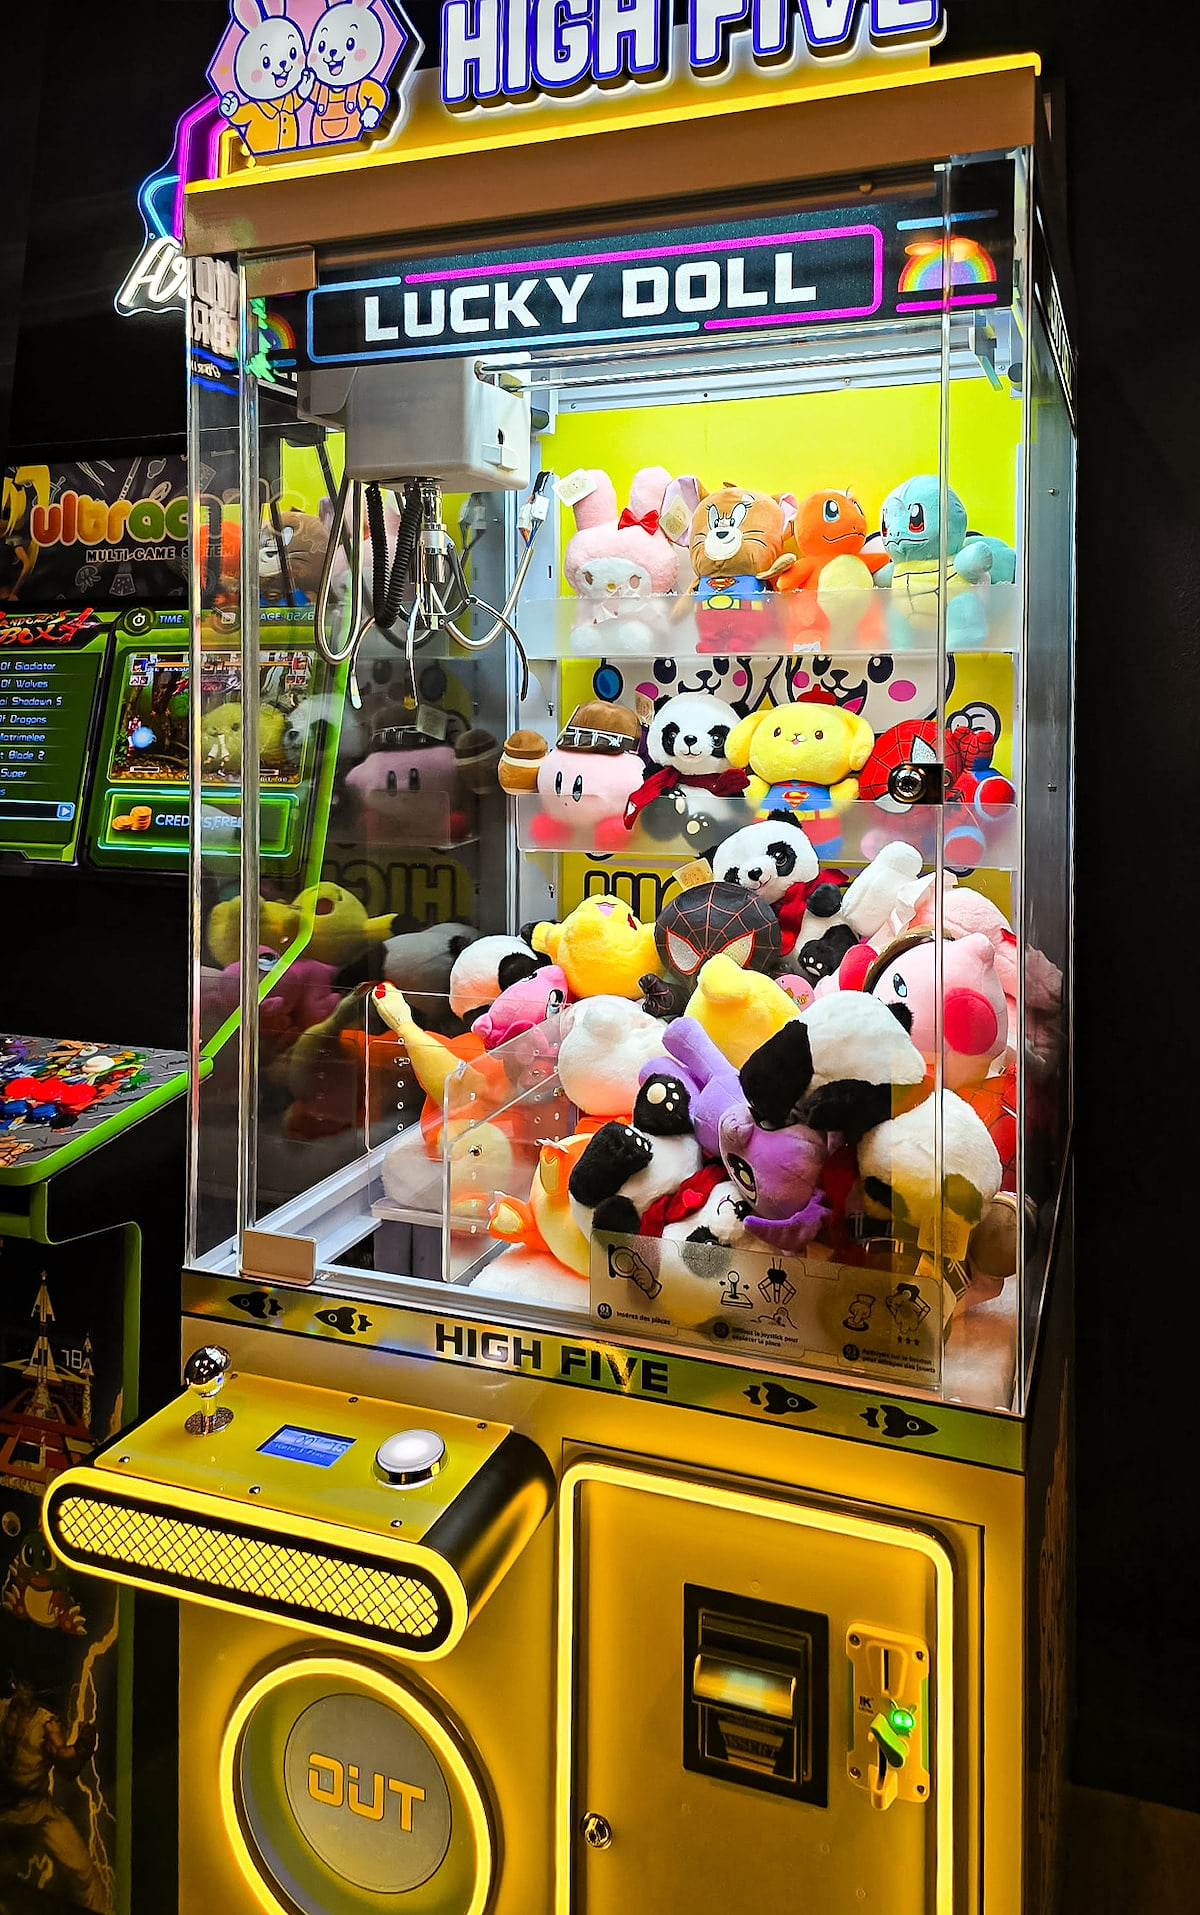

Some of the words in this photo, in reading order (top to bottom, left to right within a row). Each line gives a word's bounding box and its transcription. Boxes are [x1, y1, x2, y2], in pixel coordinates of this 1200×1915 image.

[442, 0, 660, 103] HIGH
[365, 273, 594, 342] LUCKY
[621, 252, 817, 318] DOLL
[86, 545, 177, 564] MULTI-GAME
[15, 661, 56, 671] Gladiator
[16, 679, 49, 689] Wolves
[10, 714, 48, 725] Dragons
[0, 768, 28, 779] Super
[435, 1322, 542, 1370] HIGH
[560, 1345, 669, 1394] FIVE
[307, 1752, 426, 1833] OUT
